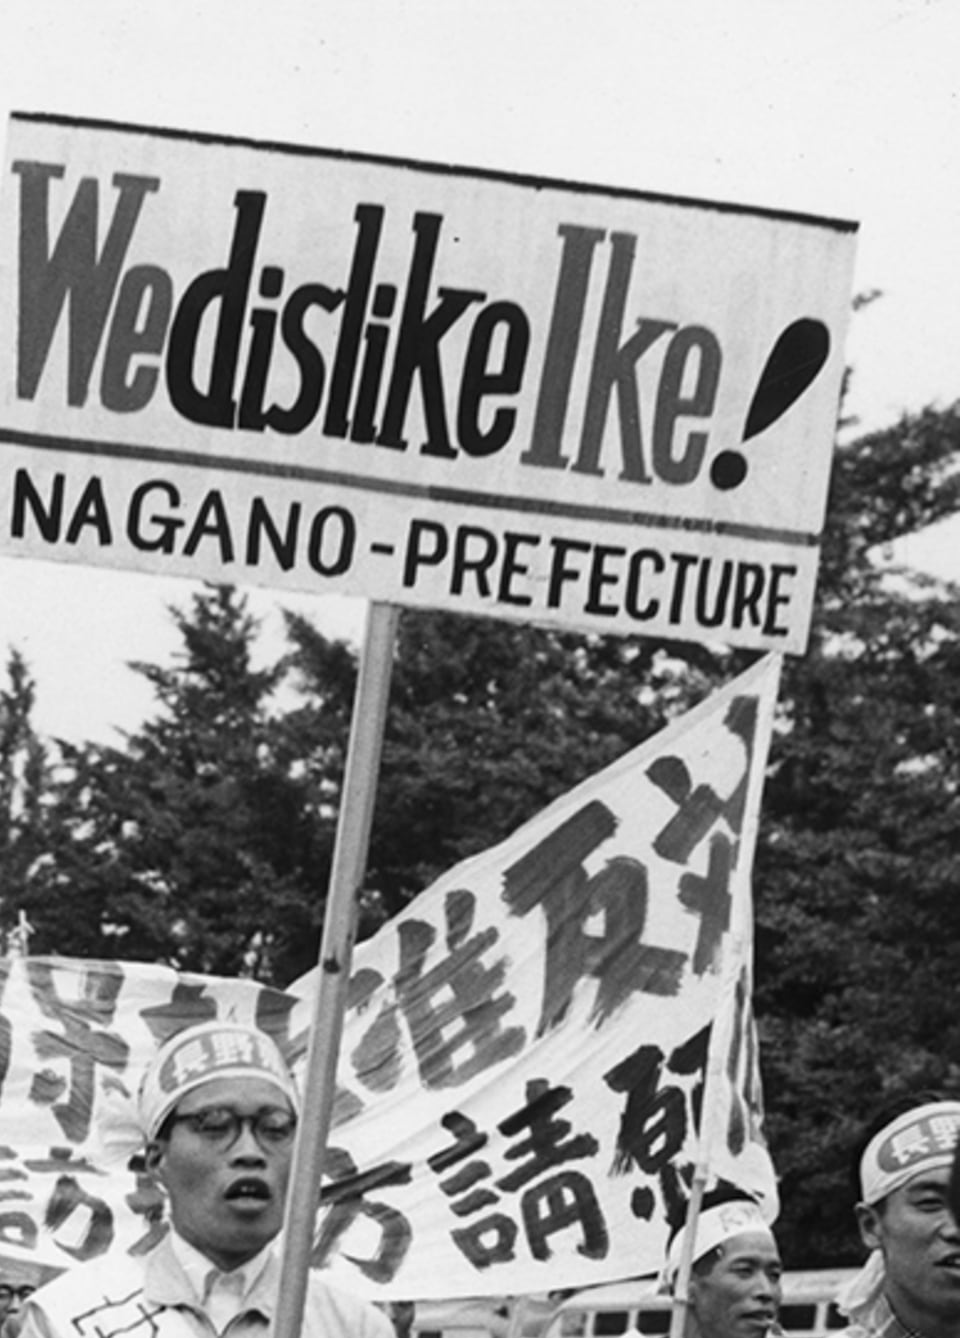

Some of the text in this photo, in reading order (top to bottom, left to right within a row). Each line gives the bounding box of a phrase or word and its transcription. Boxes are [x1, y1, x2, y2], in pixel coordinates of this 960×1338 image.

[11, 159, 831, 492] We dislike Ike!
